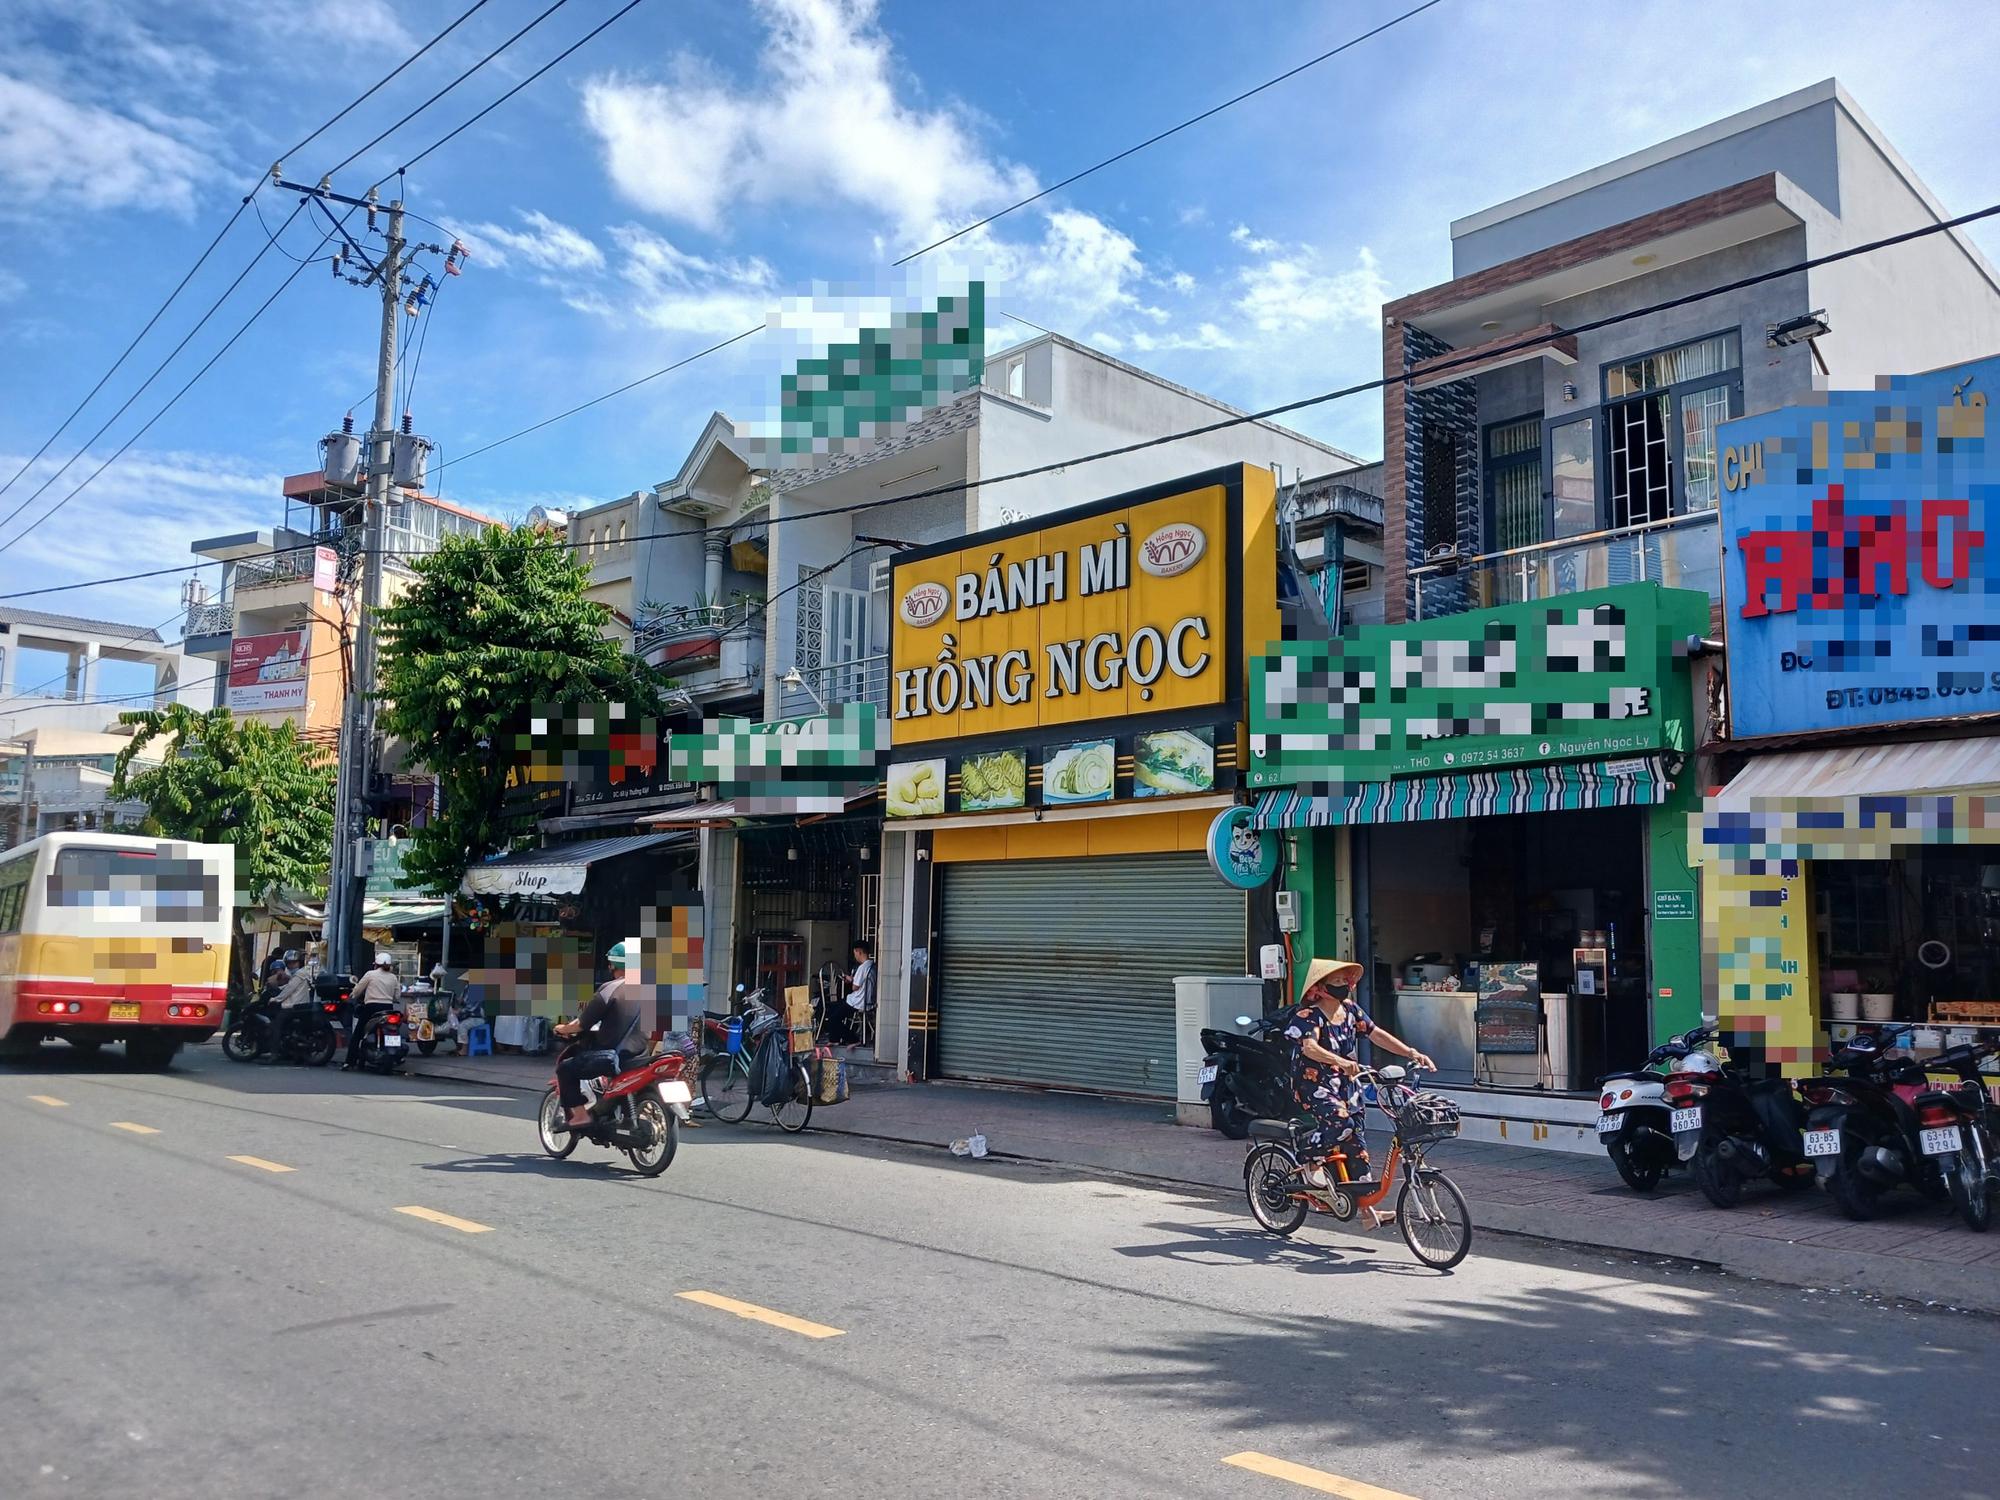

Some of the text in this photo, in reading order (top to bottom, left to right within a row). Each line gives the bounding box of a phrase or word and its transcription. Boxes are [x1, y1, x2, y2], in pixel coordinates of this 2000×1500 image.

[955, 523, 1130, 622] BÁNH MÌ
[1161, 564, 1183, 574] BAKERY
[895, 616, 1210, 720] HỒNG NGỌC
[264, 689, 290, 700] THANH
[1461, 752, 1484, 763] 0972
[1487, 750, 1498, 760] 54
[1501, 747, 1525, 759] 3637
[515, 871, 548, 889] Shop
[1675, 1109, 1697, 1120] 63-B9
[1672, 1119, 1700, 1131] 960.50
[1926, 1129, 1954, 1141] 63-FK
[1807, 1142, 1839, 1154] 545.33
[1928, 1140, 1956, 1152] 9294
